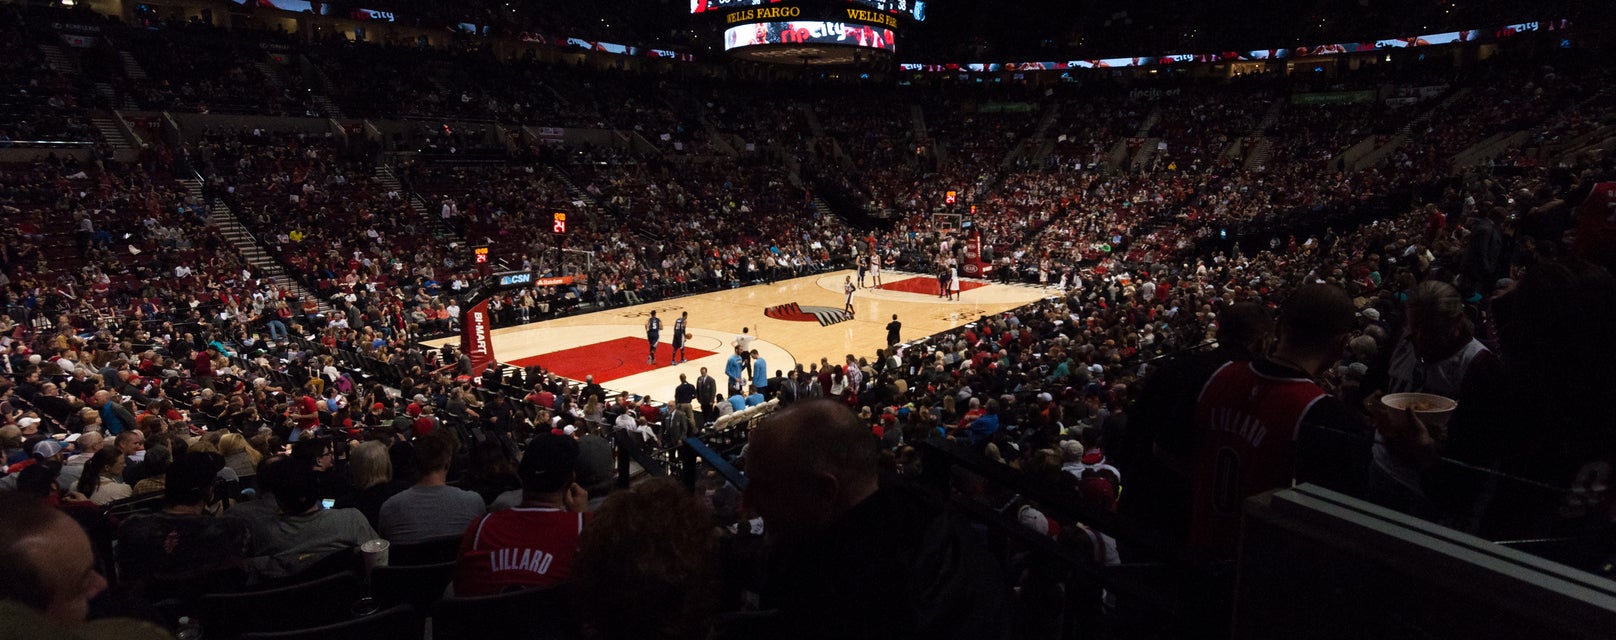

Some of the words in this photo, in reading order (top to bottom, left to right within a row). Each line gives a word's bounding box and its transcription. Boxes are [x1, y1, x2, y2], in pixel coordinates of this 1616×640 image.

[727, 10, 754, 23] WELLS
[757, 7, 800, 18] FARGO
[847, 9, 885, 23] WELLS
[554, 220, 565, 233] 24
[477, 254, 487, 263] 24
[511, 274, 530, 284] CSN
[652, 322, 657, 330] 5
[1208, 407, 1268, 448] LILLARD
[490, 548, 554, 575] LILLARD
